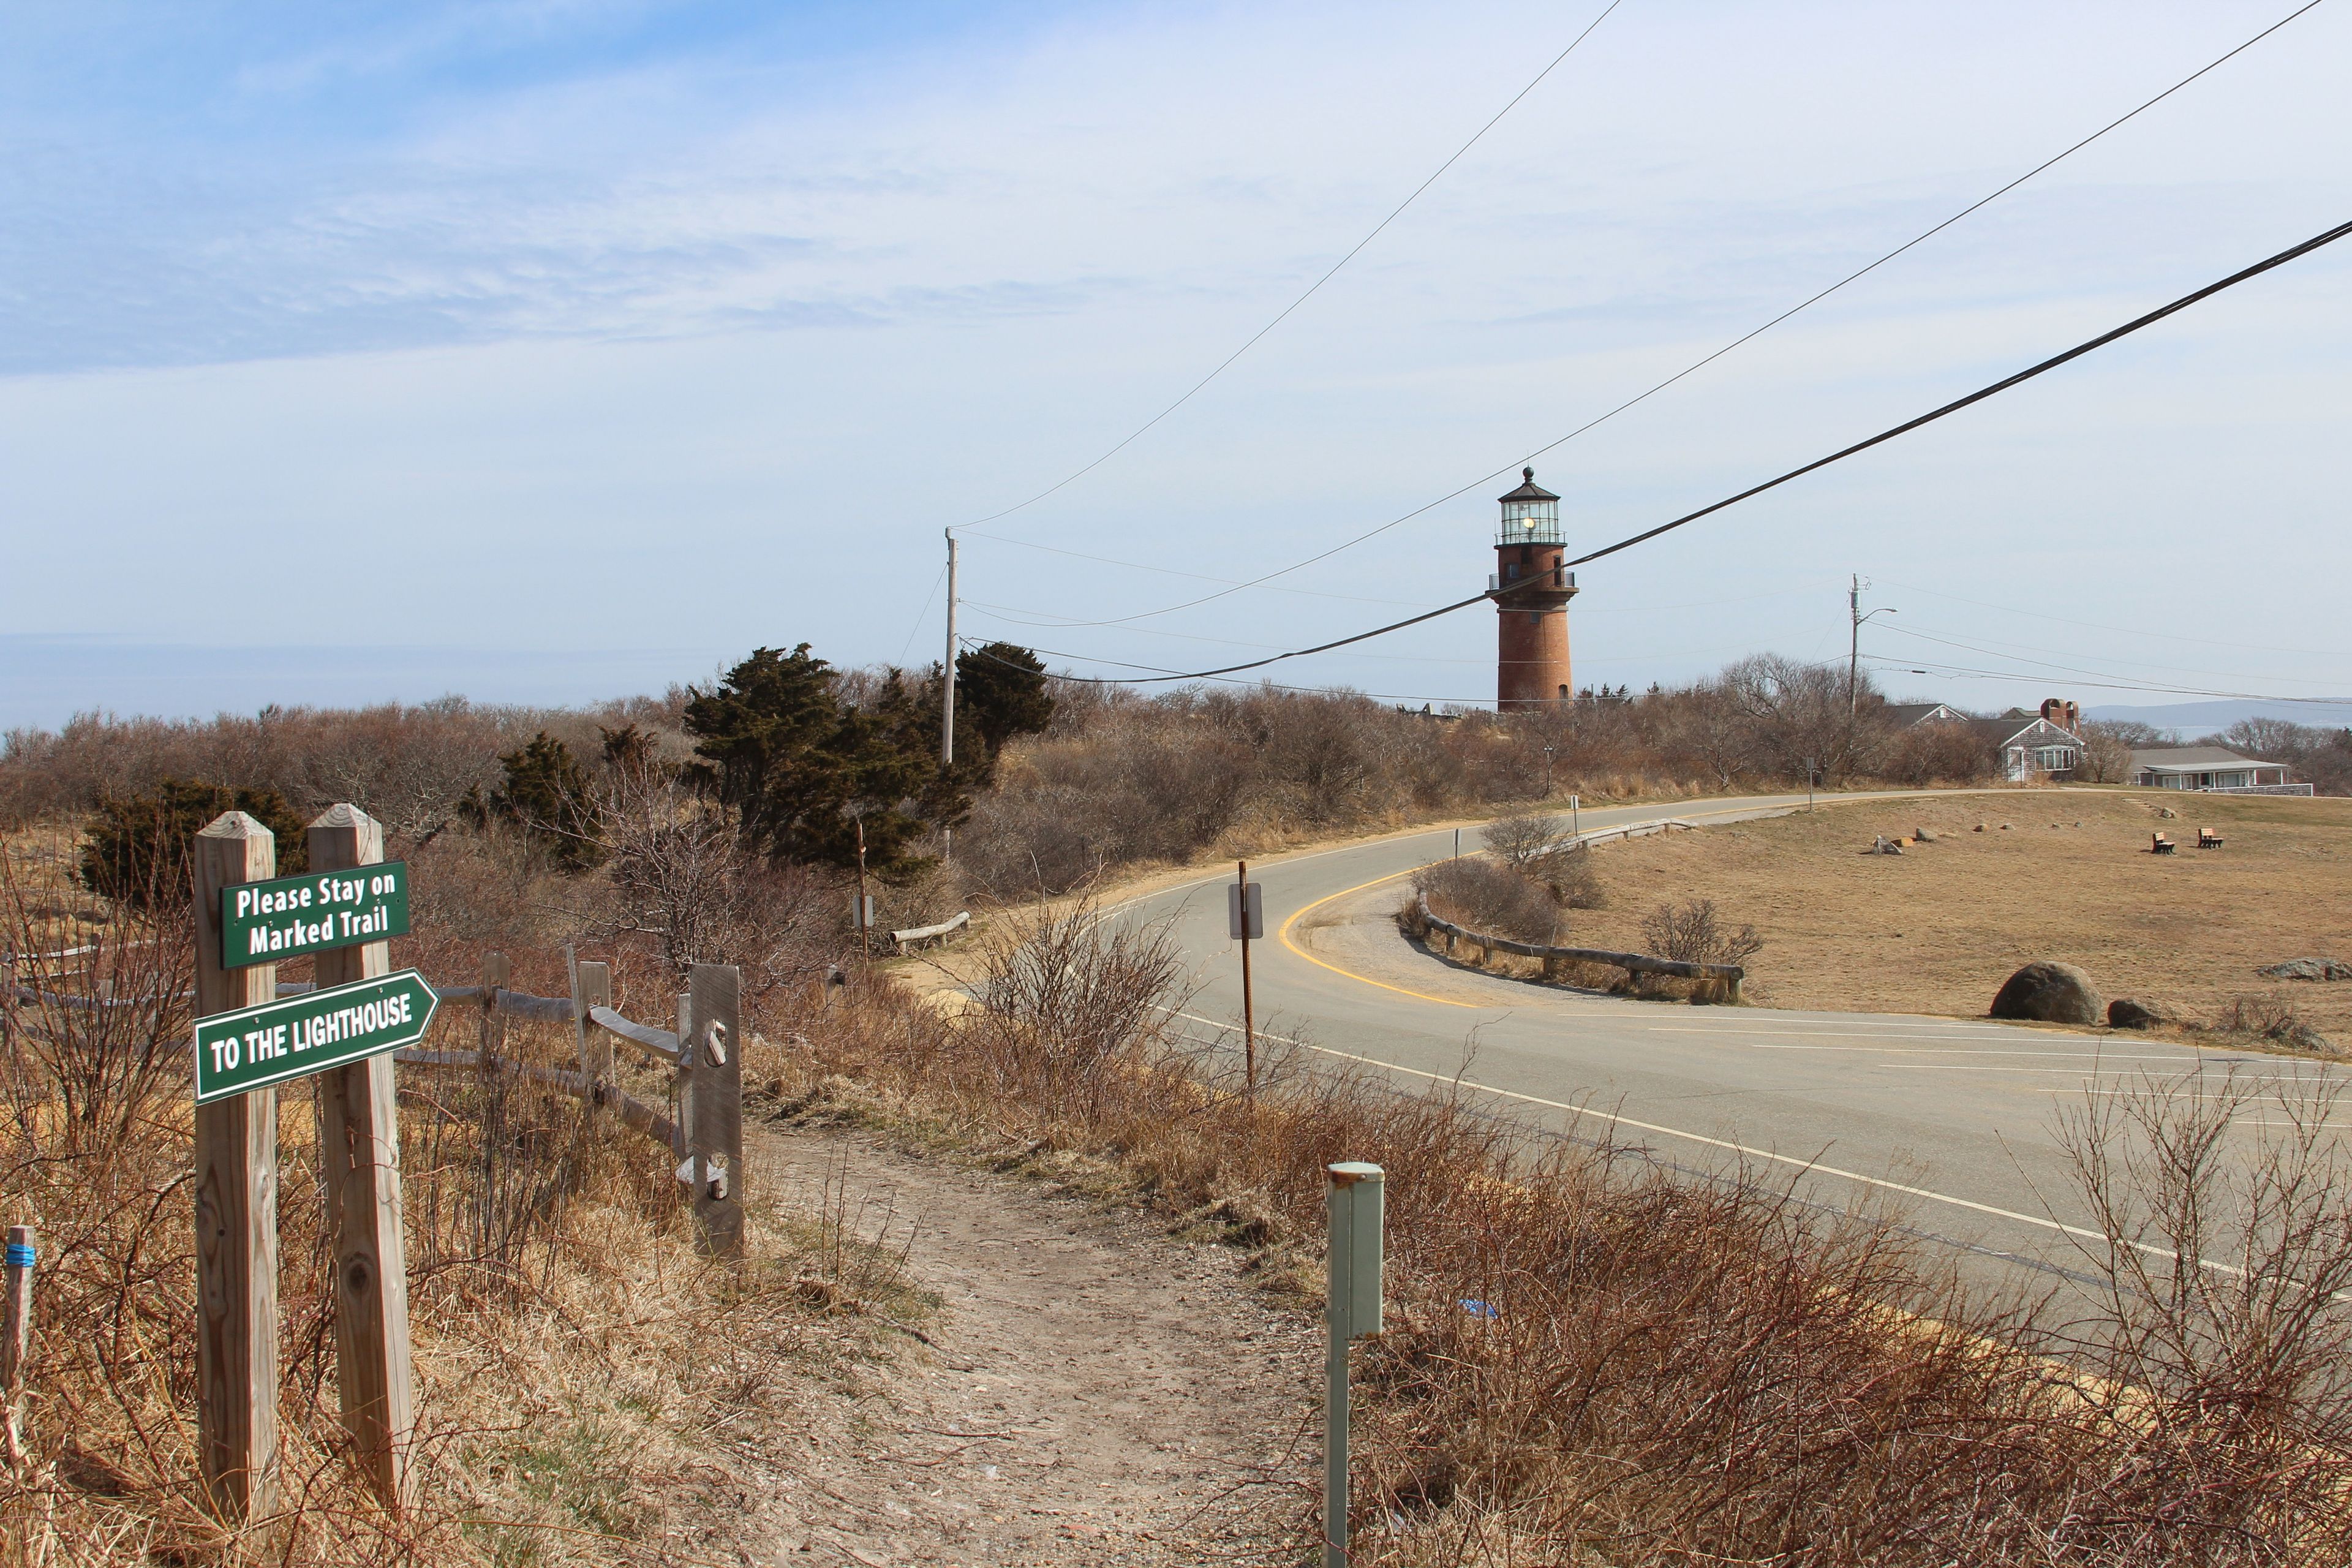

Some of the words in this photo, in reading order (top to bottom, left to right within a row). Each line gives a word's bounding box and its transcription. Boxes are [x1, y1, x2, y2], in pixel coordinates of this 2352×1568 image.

[236, 888, 312, 918] Please
[318, 878, 365, 905] Stay
[371, 874, 395, 895] on
[250, 914, 334, 955] Marked
[340, 905, 388, 938] Trail
[211, 1037, 240, 1073] TO
[245, 1024, 287, 1064] THE
[292, 993, 412, 1052] LIGHTHOUSE
